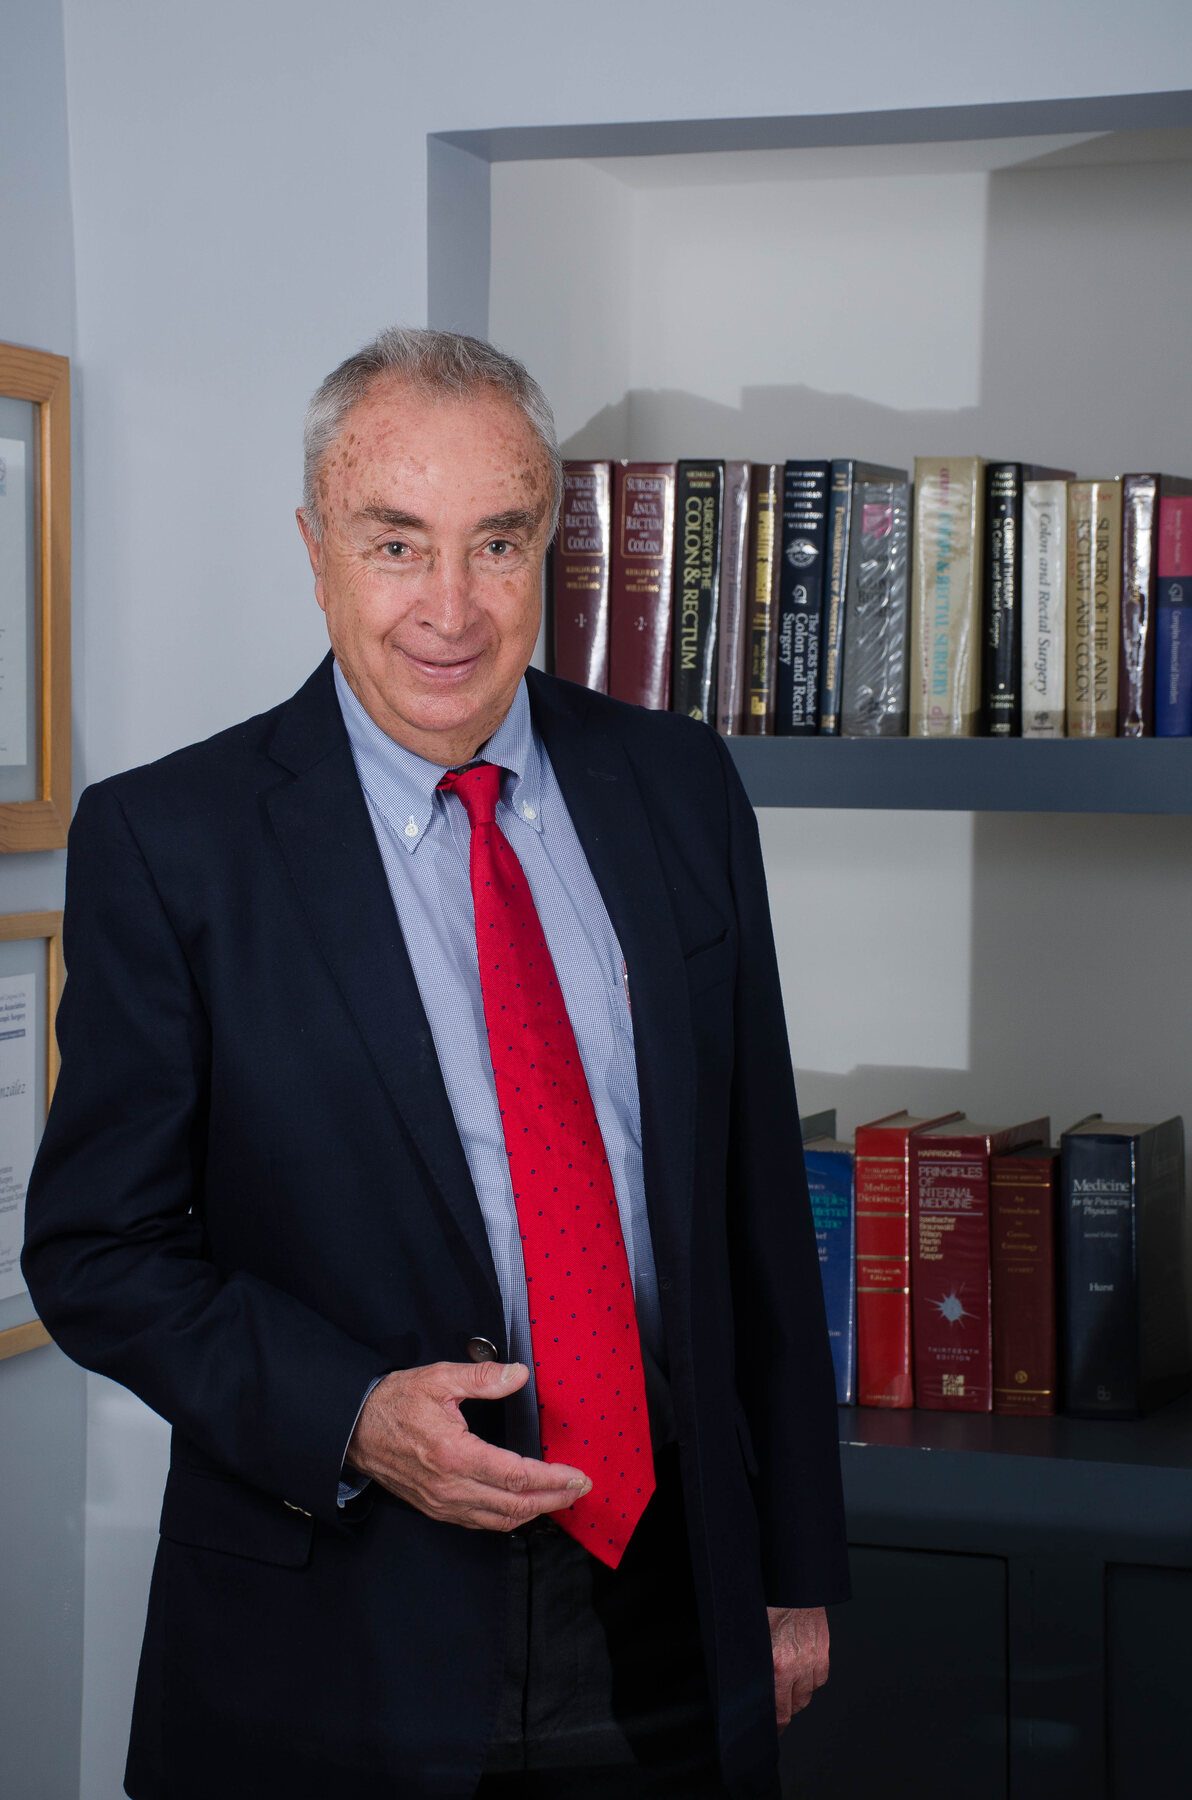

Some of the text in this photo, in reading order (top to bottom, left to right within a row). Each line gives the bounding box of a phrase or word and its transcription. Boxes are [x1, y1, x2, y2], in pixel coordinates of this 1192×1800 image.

[565, 476, 599, 489] SURGER
[632, 501, 657, 515] ANUS
[625, 515, 664, 530] RECTUM
[683, 496, 702, 565] COLON
[567, 536, 599, 550] COLON
[700, 496, 714, 589] SURGERY OF THE
[1038, 513, 1053, 554] Colon
[627, 538, 660, 553] COLON
[683, 567, 701, 583] &
[991, 560, 1002, 580] and
[1037, 557, 1052, 586] and
[935, 575, 952, 627] RECTAL
[1094, 518, 1110, 702] SURGERY OF THE ANUS
[1036, 590, 1051, 633] Rectal
[1076, 599, 1090, 638] AND
[681, 589, 699, 670] RECTUM
[779, 612, 794, 666] Surgery
[792, 612, 808, 727] Colon and Rectal
[805, 613, 819, 727] The ASCRS Textbook of
[931, 634, 949, 697] SURGERY
[1034, 637, 1051, 696] Surgery
[1076, 642, 1090, 702] COLON
[918, 1166, 983, 1178] PRINCIPLES
[918, 1176, 935, 1187] OF
[919, 1187, 974, 1199] INTERNAL
[1073, 1178, 1131, 1192] Medicine
[918, 1198, 973, 1209] MEDICINE
[919, 1238, 942, 1246] Martin
[1089, 1282, 1114, 1292] Hurst
[928, 1346, 980, 1355] THIRTEENTH
[935, 1354, 971, 1362] EDITION
